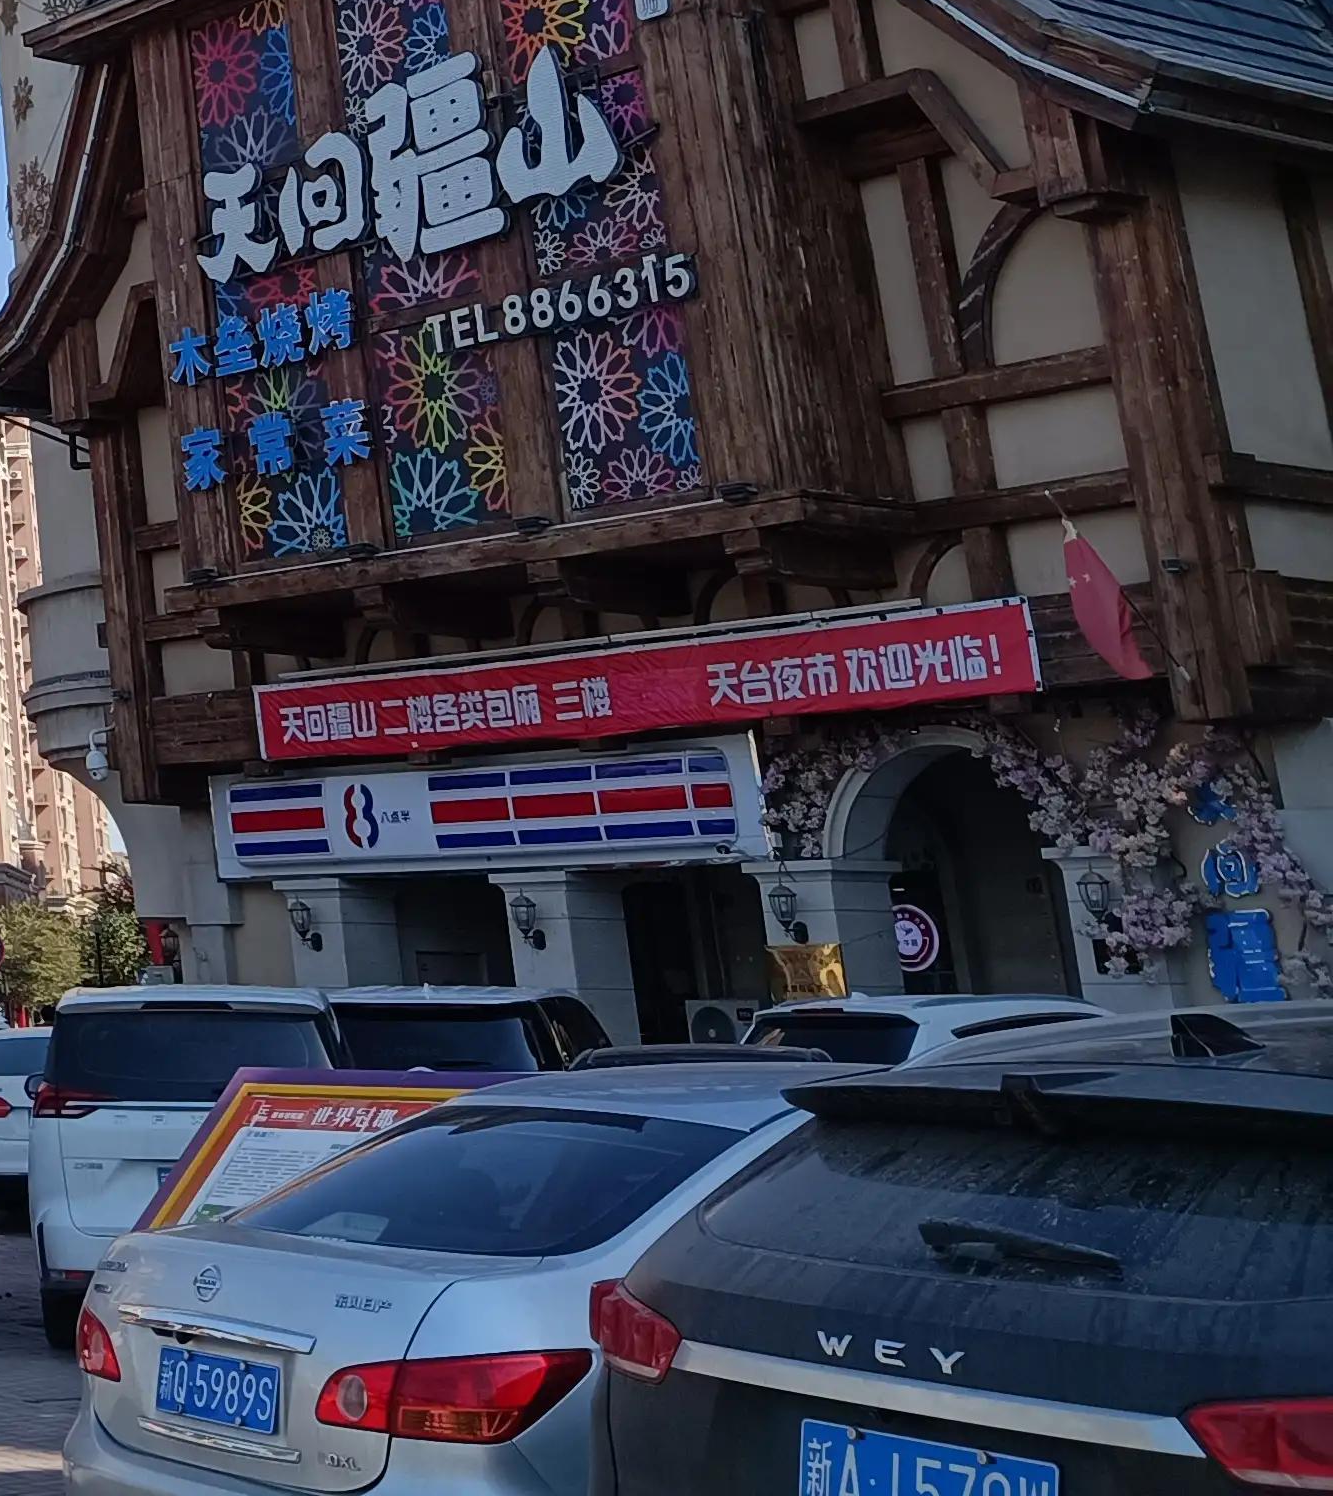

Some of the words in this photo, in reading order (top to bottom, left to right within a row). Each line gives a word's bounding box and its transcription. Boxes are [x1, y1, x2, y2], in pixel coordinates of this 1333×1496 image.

[179, 398, 372, 492] 家常菜
[279, 700, 376, 744] 天回疆山
[553, 677, 613, 721] 三楼
[706, 653, 838, 706] 天台夜市
[817, 1330, 965, 1375] WEY
